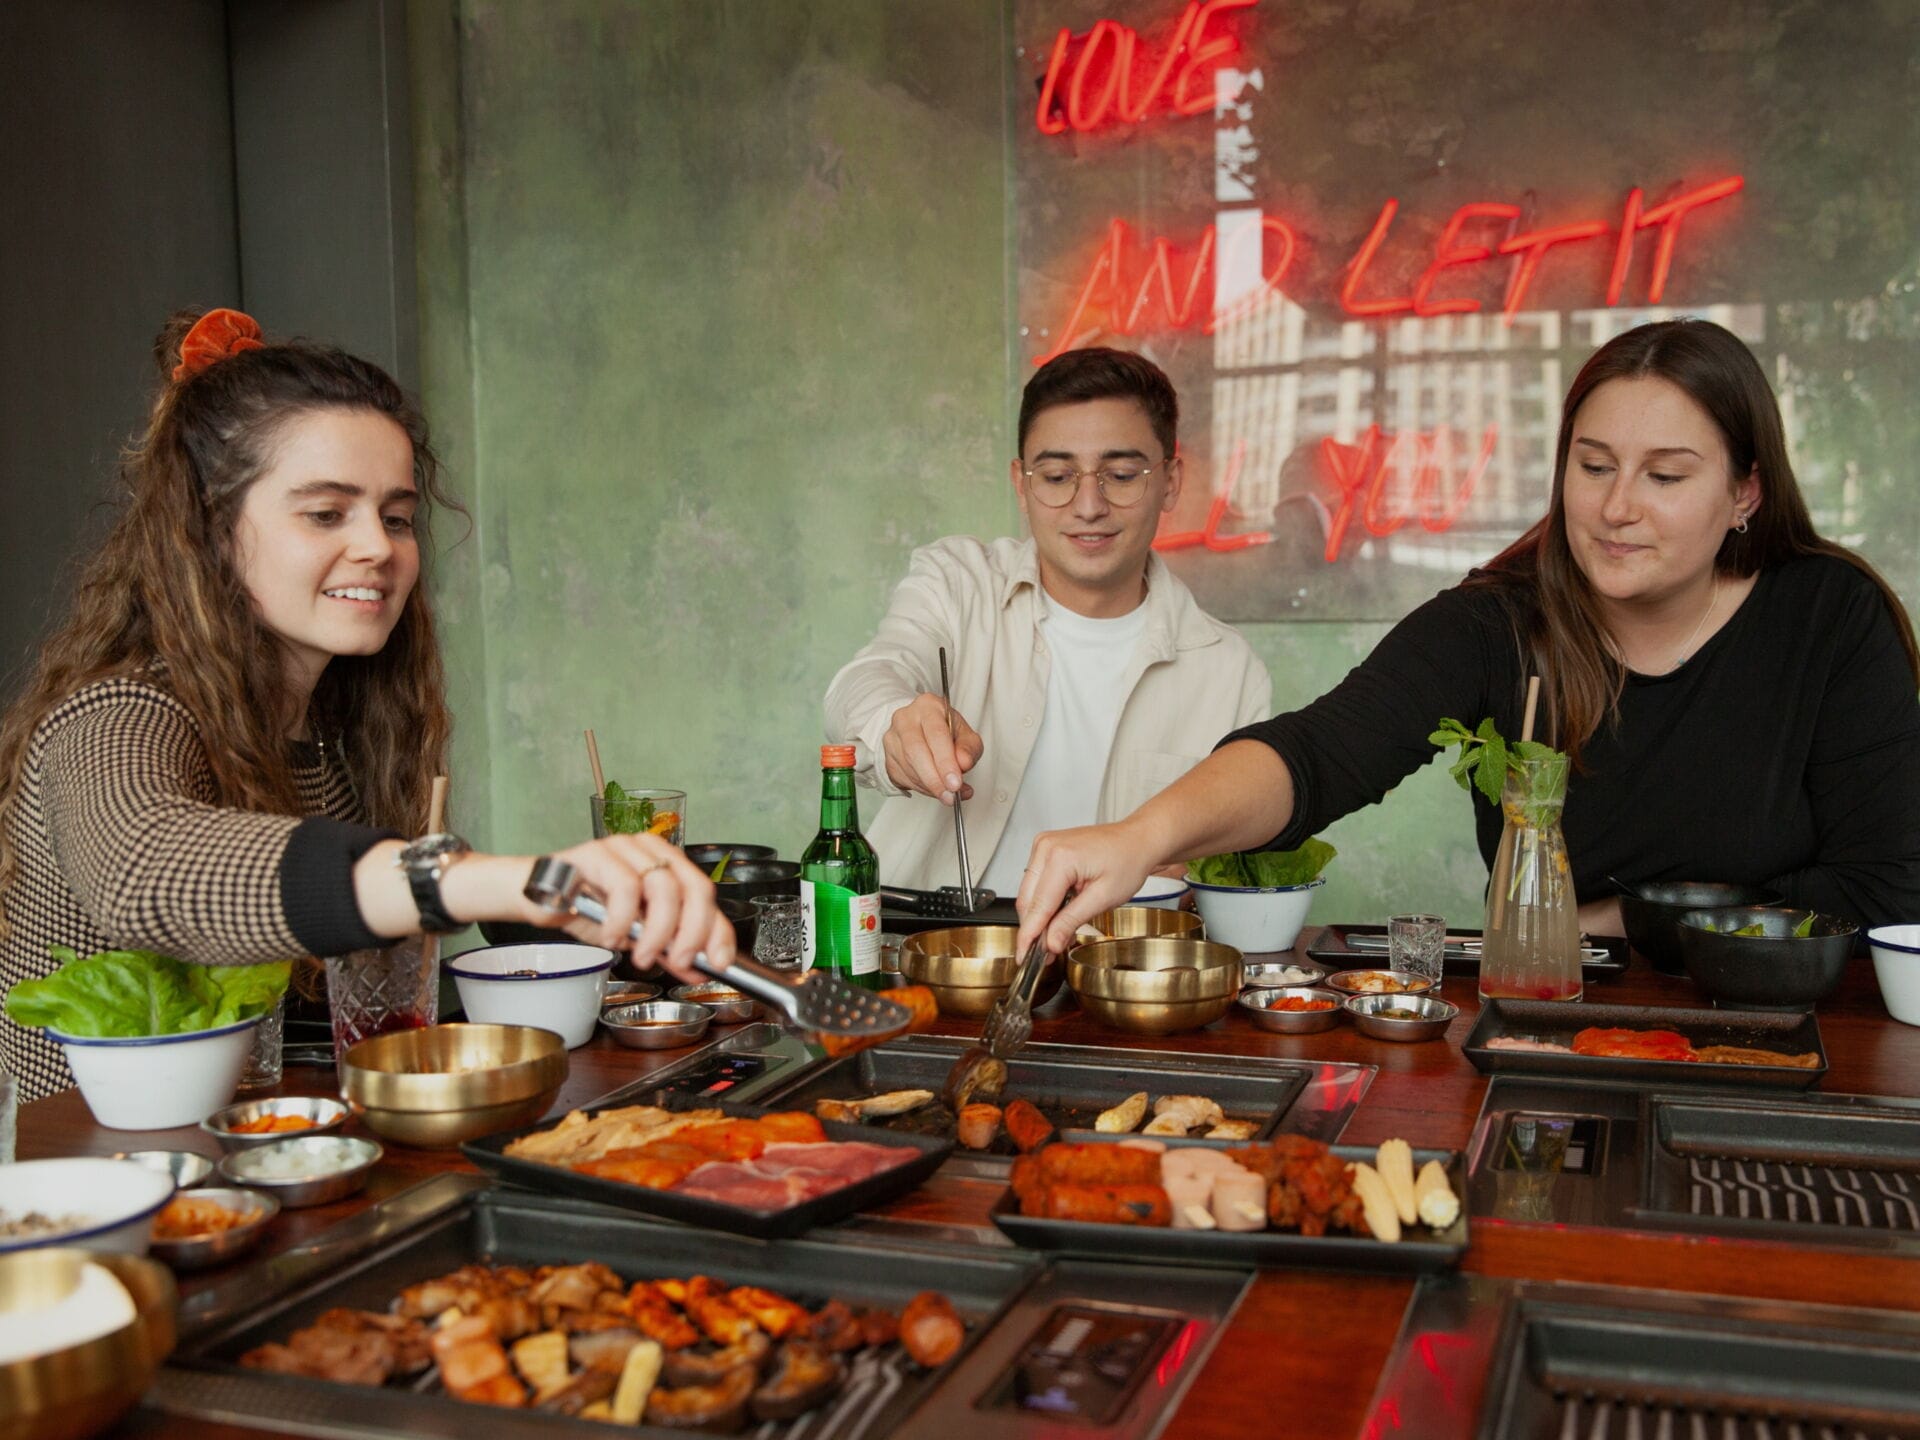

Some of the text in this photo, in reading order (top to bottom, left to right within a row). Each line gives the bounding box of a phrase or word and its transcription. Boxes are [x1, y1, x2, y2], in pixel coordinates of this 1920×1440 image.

[1036, 0, 1258, 134] LOVE
[1031, 174, 1744, 367] AND LET IT
[1321, 423, 1499, 562] YOU
